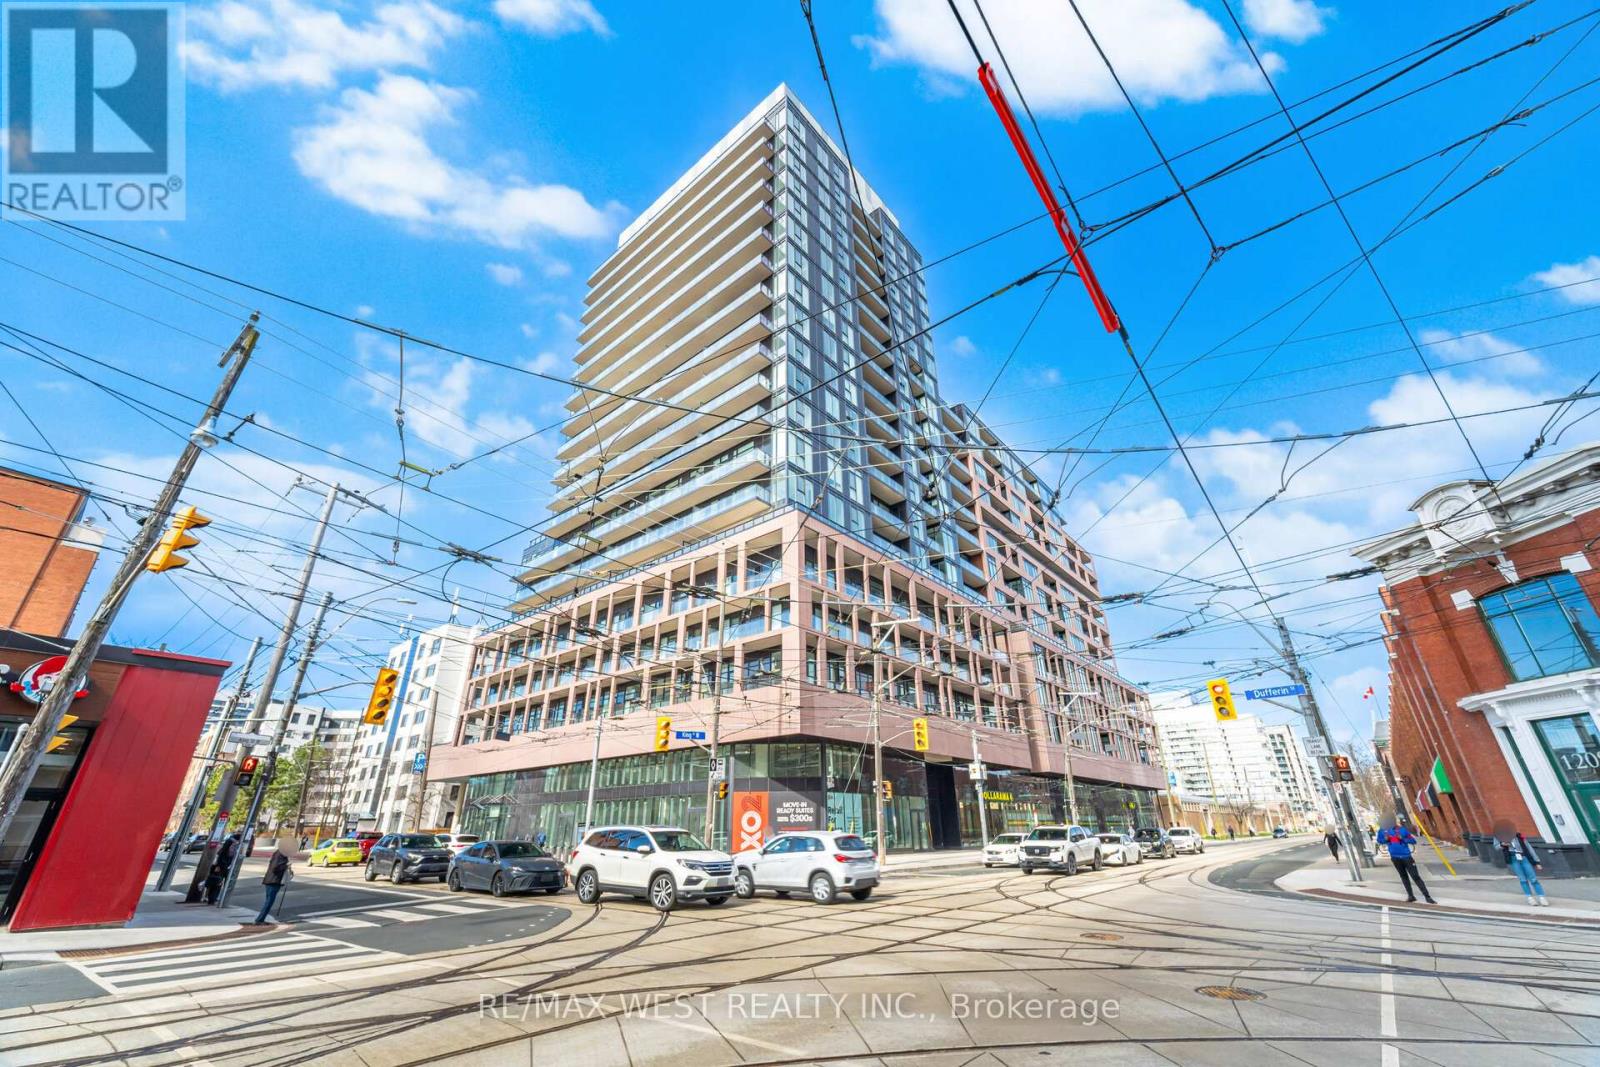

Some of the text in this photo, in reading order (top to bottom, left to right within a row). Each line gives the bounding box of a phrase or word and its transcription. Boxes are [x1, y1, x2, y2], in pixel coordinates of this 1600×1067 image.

[1253, 687, 1290, 698] Dufferin
[1560, 751, 1600, 770] 120
[789, 814, 813, 823] $300s
